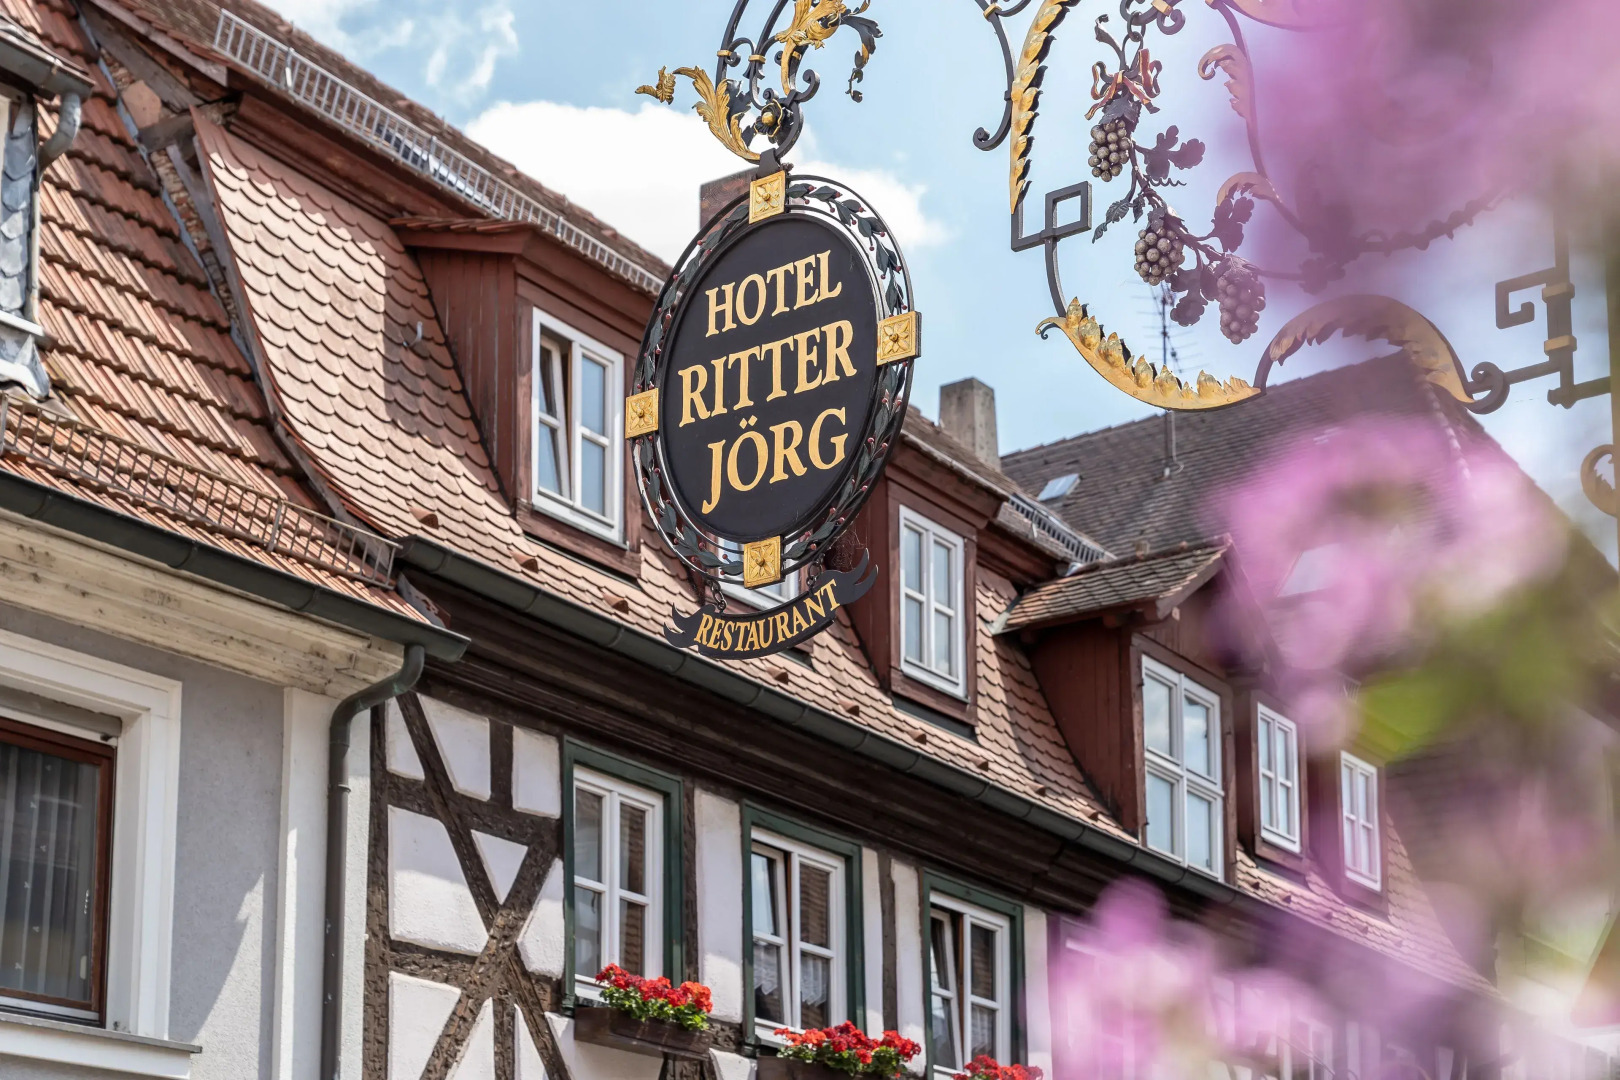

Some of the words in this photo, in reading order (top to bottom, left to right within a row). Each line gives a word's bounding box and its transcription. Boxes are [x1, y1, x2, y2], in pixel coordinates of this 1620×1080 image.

[705, 249, 843, 338] HOTEL
[677, 319, 857, 428] RITTER
[701, 406, 849, 515] JÖRG
[694, 579, 841, 652] RESTAURANT
